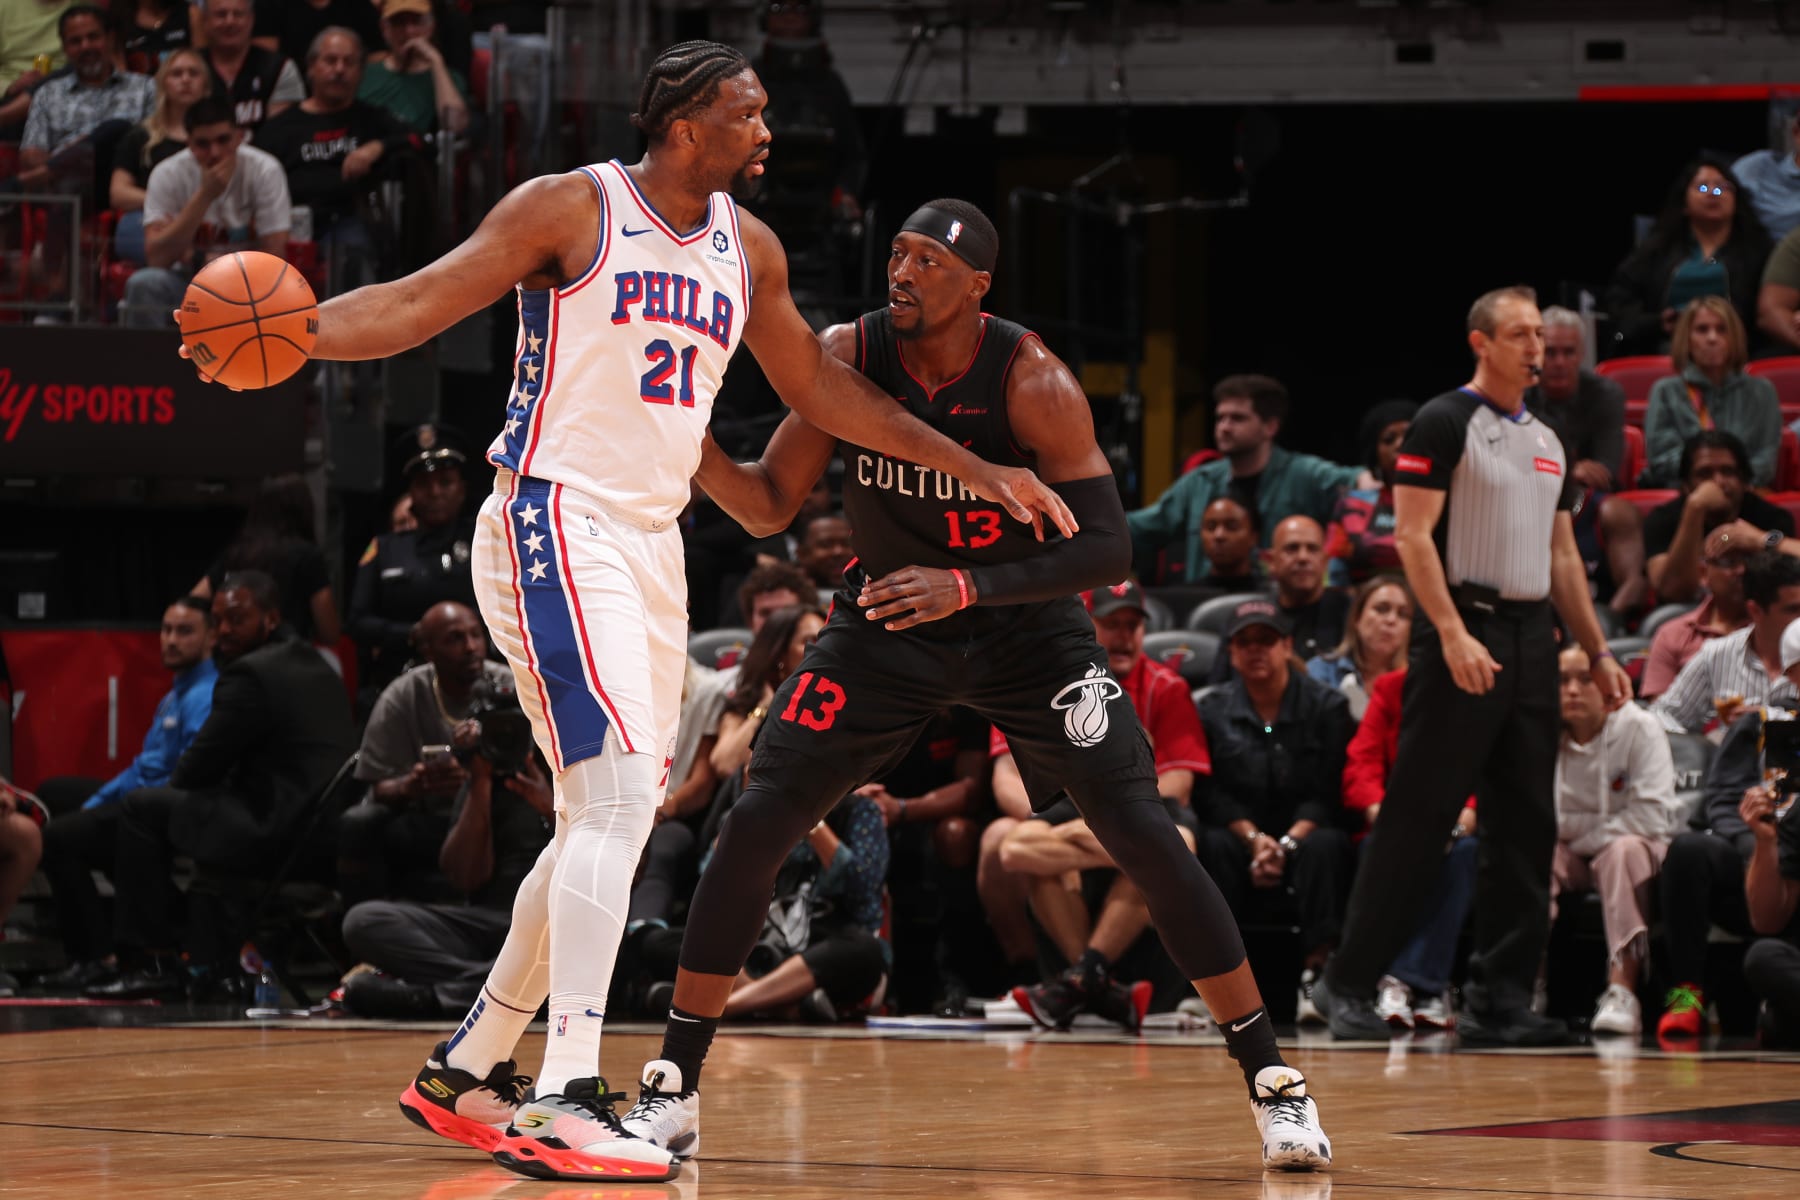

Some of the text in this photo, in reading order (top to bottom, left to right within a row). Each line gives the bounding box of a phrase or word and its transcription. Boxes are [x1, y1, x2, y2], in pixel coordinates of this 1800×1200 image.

[611, 270, 734, 351] PHILA
[640, 338, 699, 408] 21
[42, 384, 175, 424] SPORTS
[857, 454, 977, 501] CULTUR
[944, 509, 1003, 549] 13
[781, 672, 847, 731] 13
